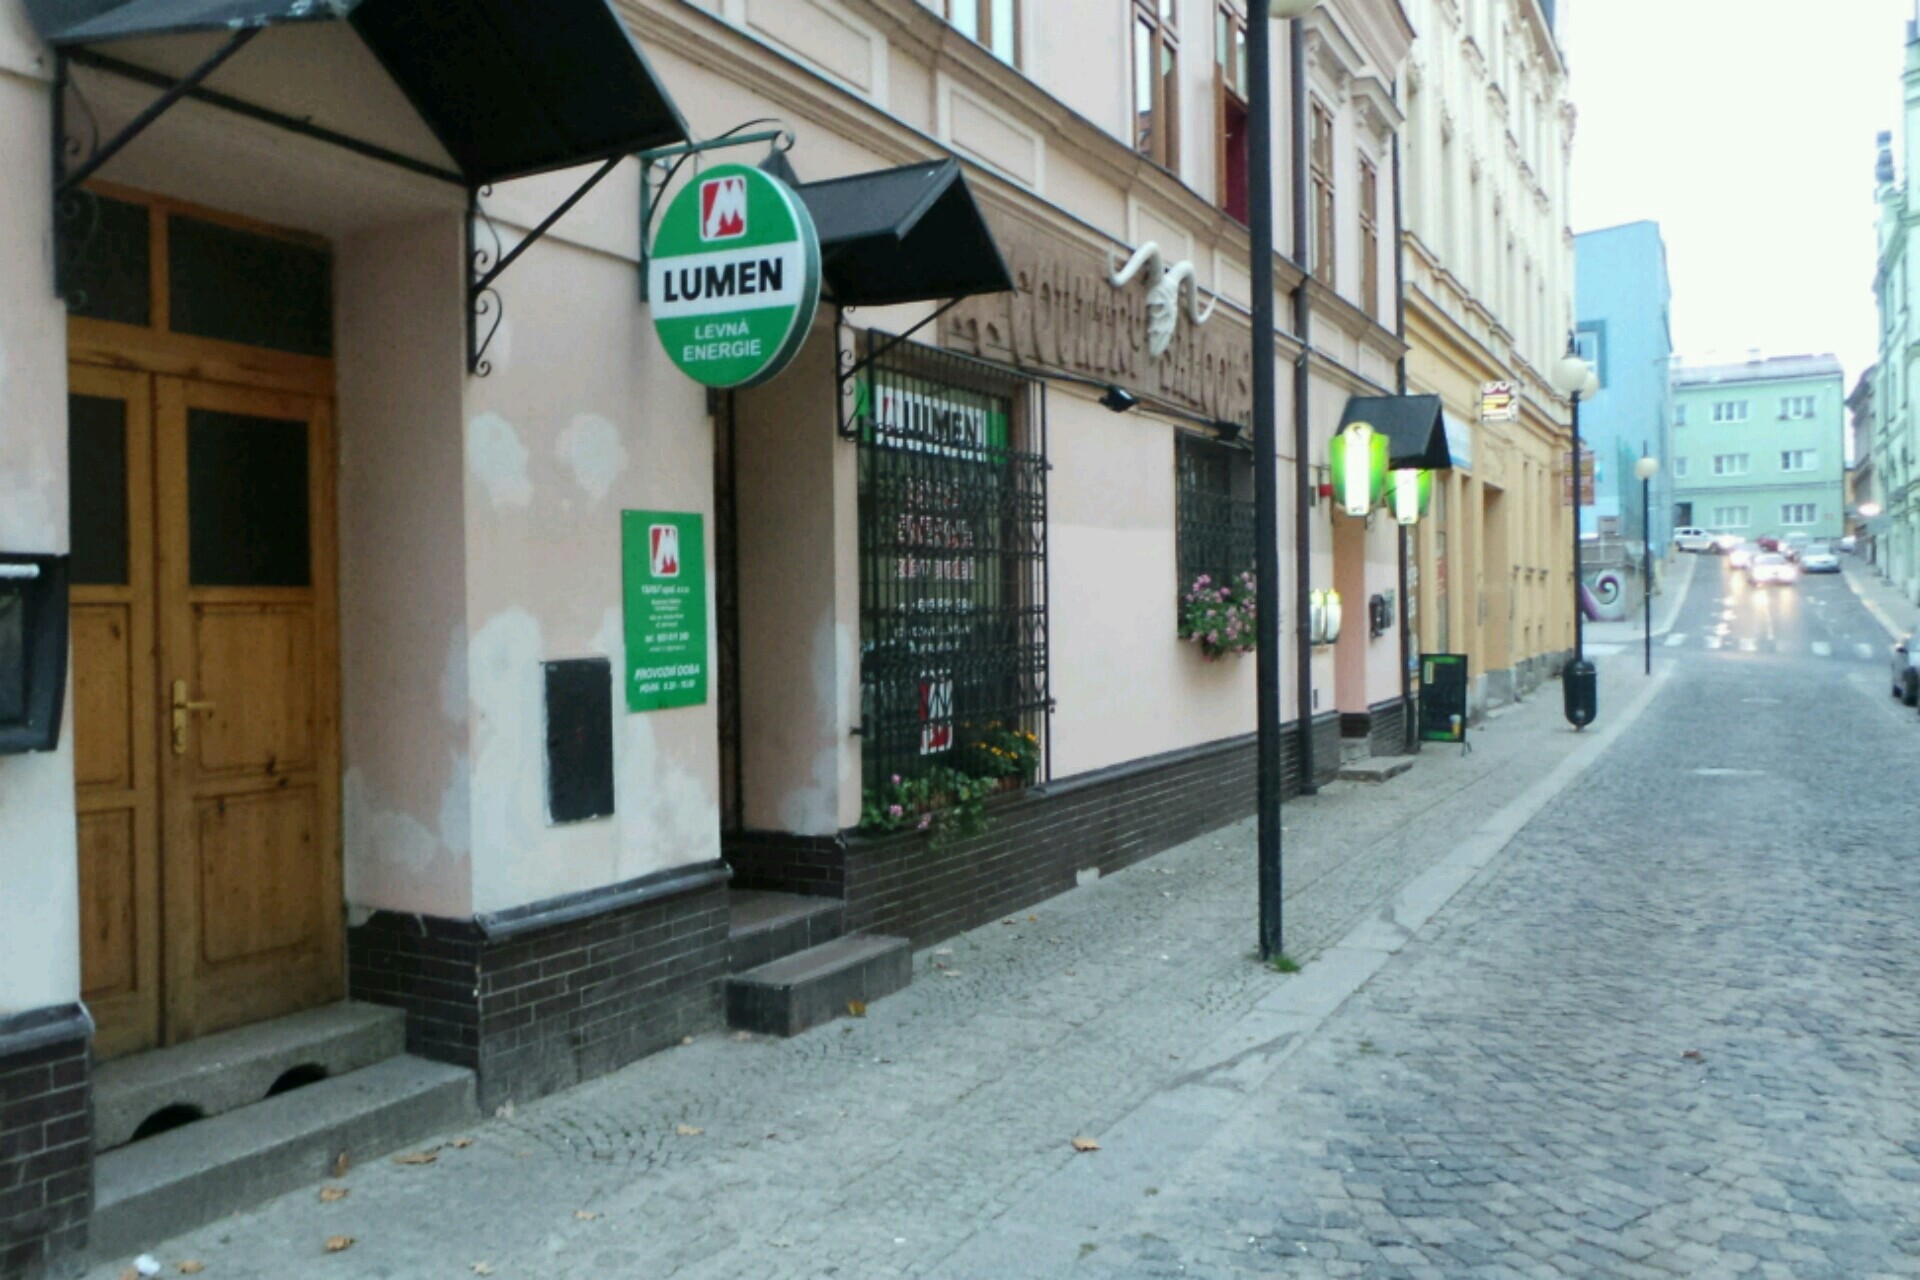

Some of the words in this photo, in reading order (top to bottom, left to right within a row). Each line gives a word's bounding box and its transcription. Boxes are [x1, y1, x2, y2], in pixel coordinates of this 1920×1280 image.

[663, 257, 783, 302] LUMEN
[694, 319, 750, 339] LEVNÁ
[682, 340, 762, 362] ENERGIE
